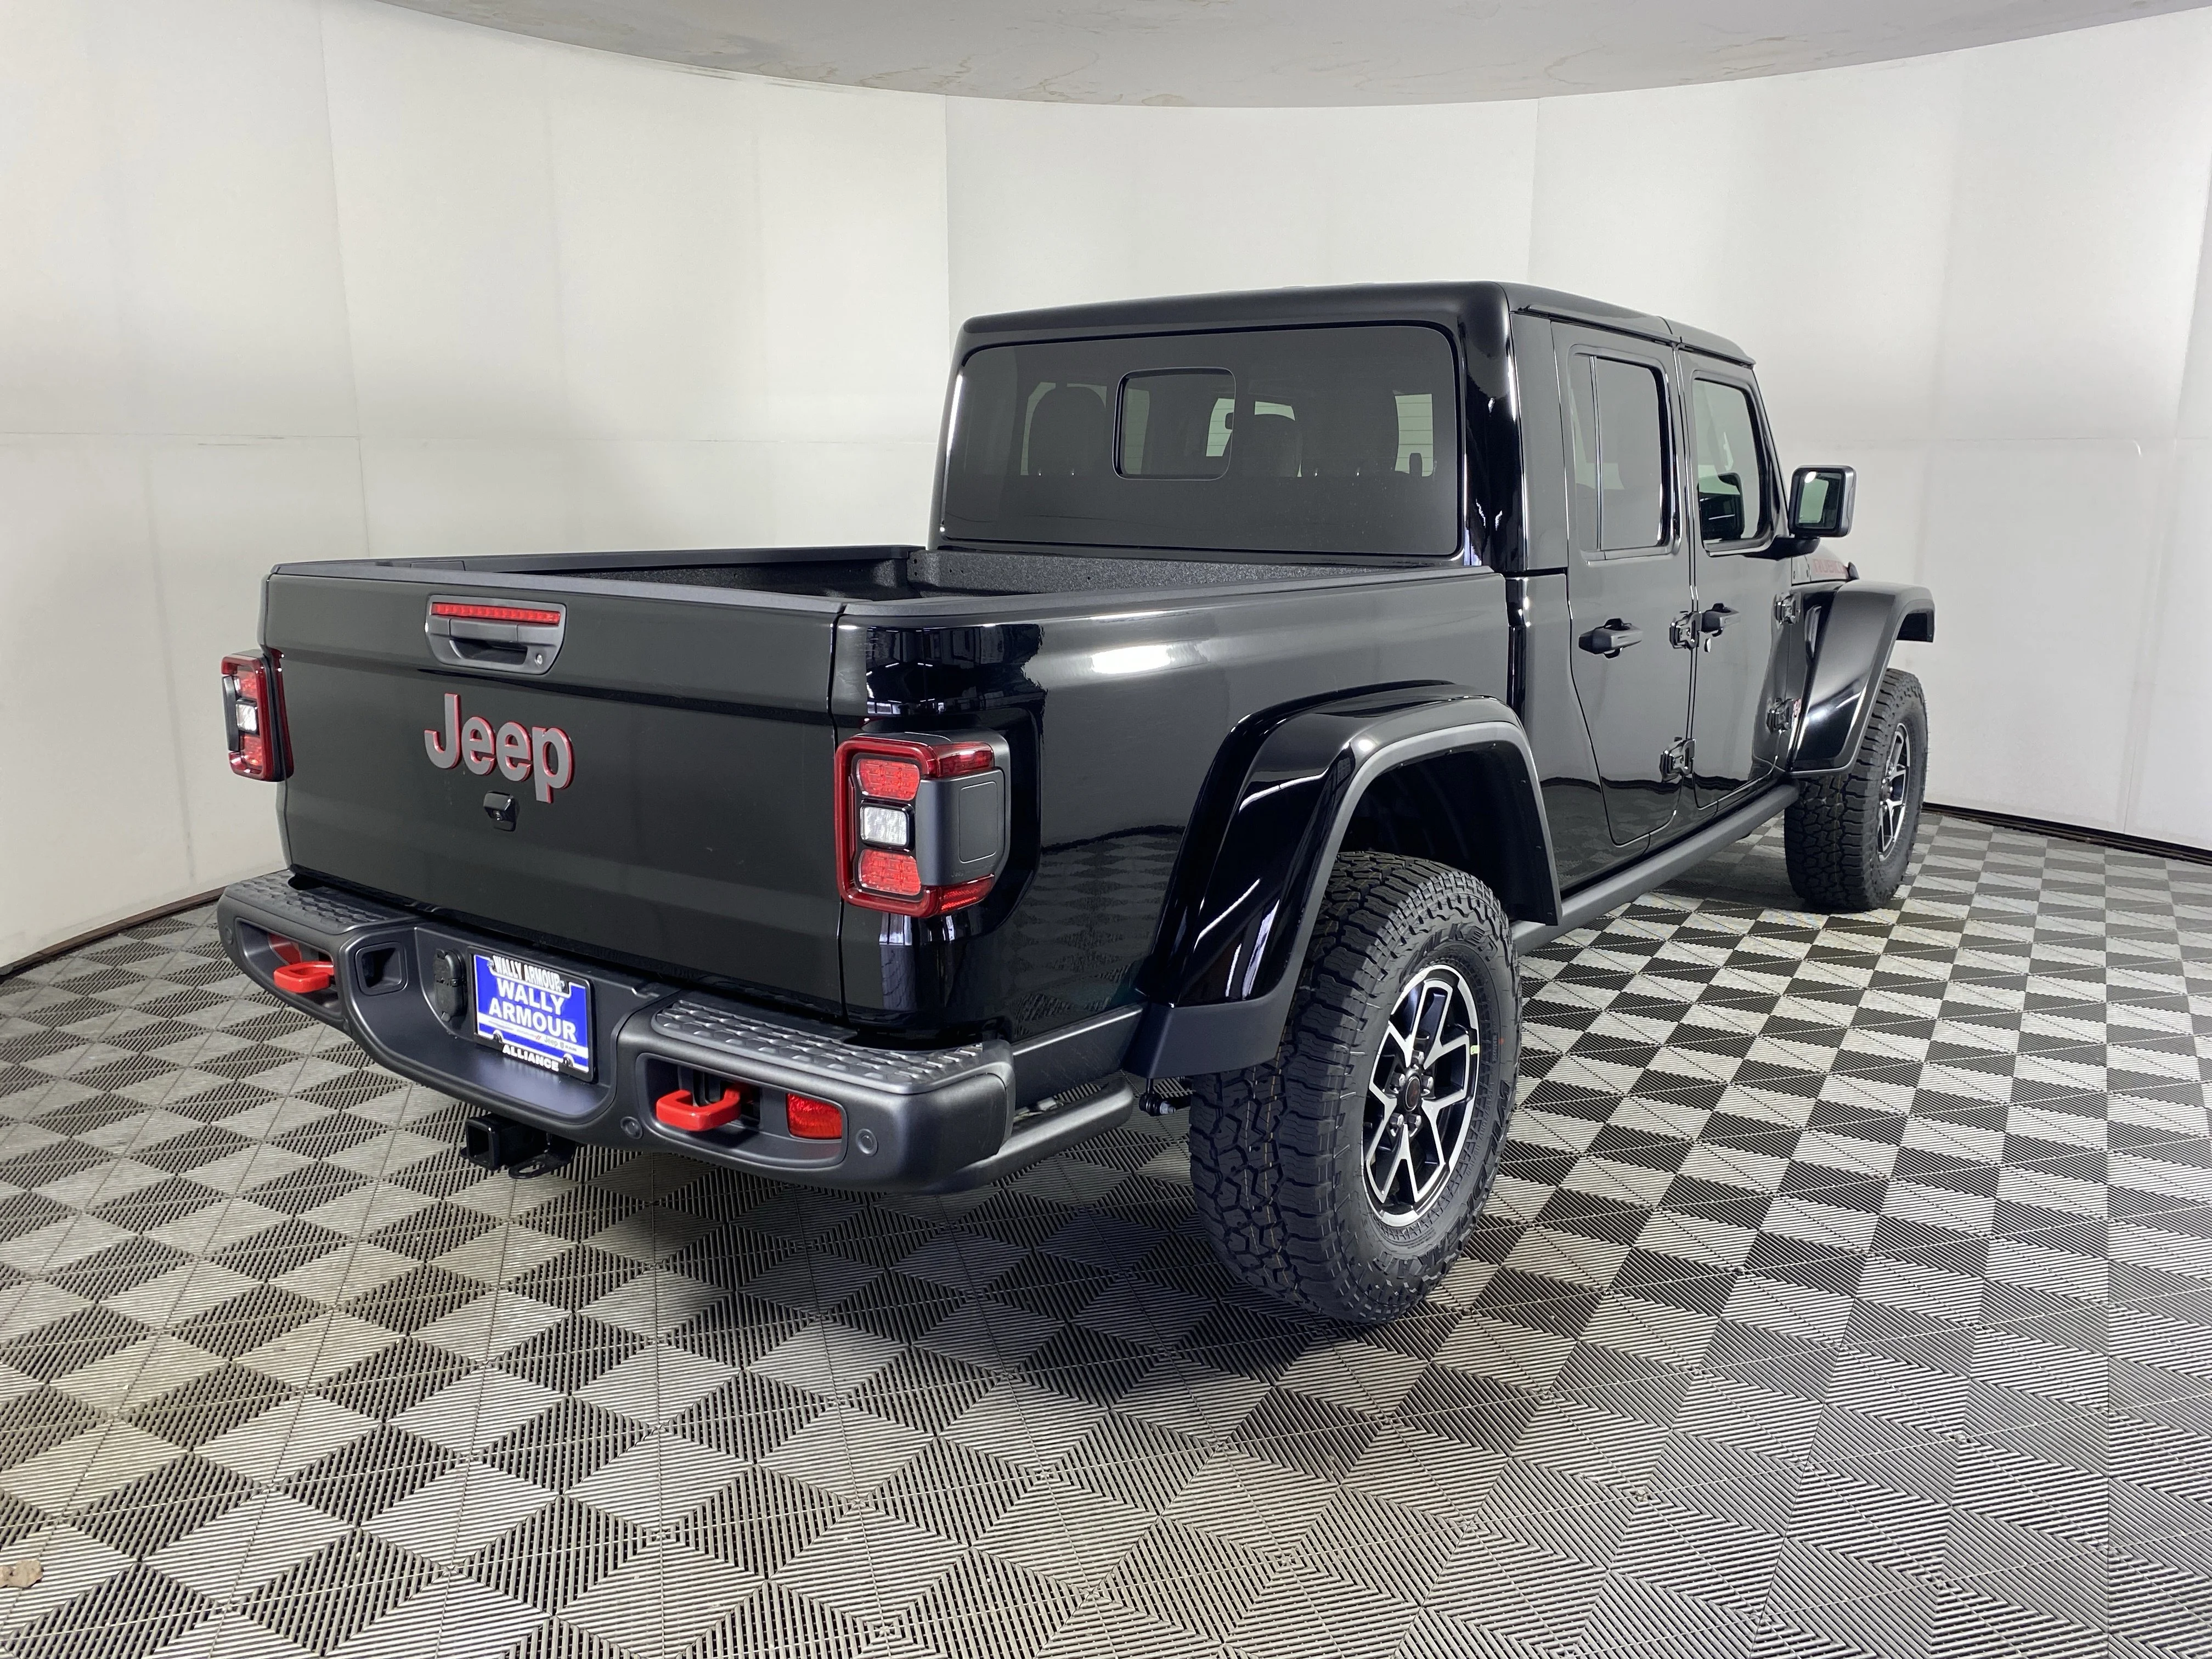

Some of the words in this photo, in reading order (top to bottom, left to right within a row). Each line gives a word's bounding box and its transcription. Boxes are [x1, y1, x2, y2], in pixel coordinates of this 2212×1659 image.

[424, 693, 574, 803] Jeep
[493, 955, 522, 980] WALLY
[524, 964, 562, 992] ARMOUR
[496, 978, 565, 1015] WALLY
[489, 997, 577, 1042] ARMOUR
[503, 1044, 560, 1072] ALLIANCE
[544, 1035, 558, 1047] Jeep
